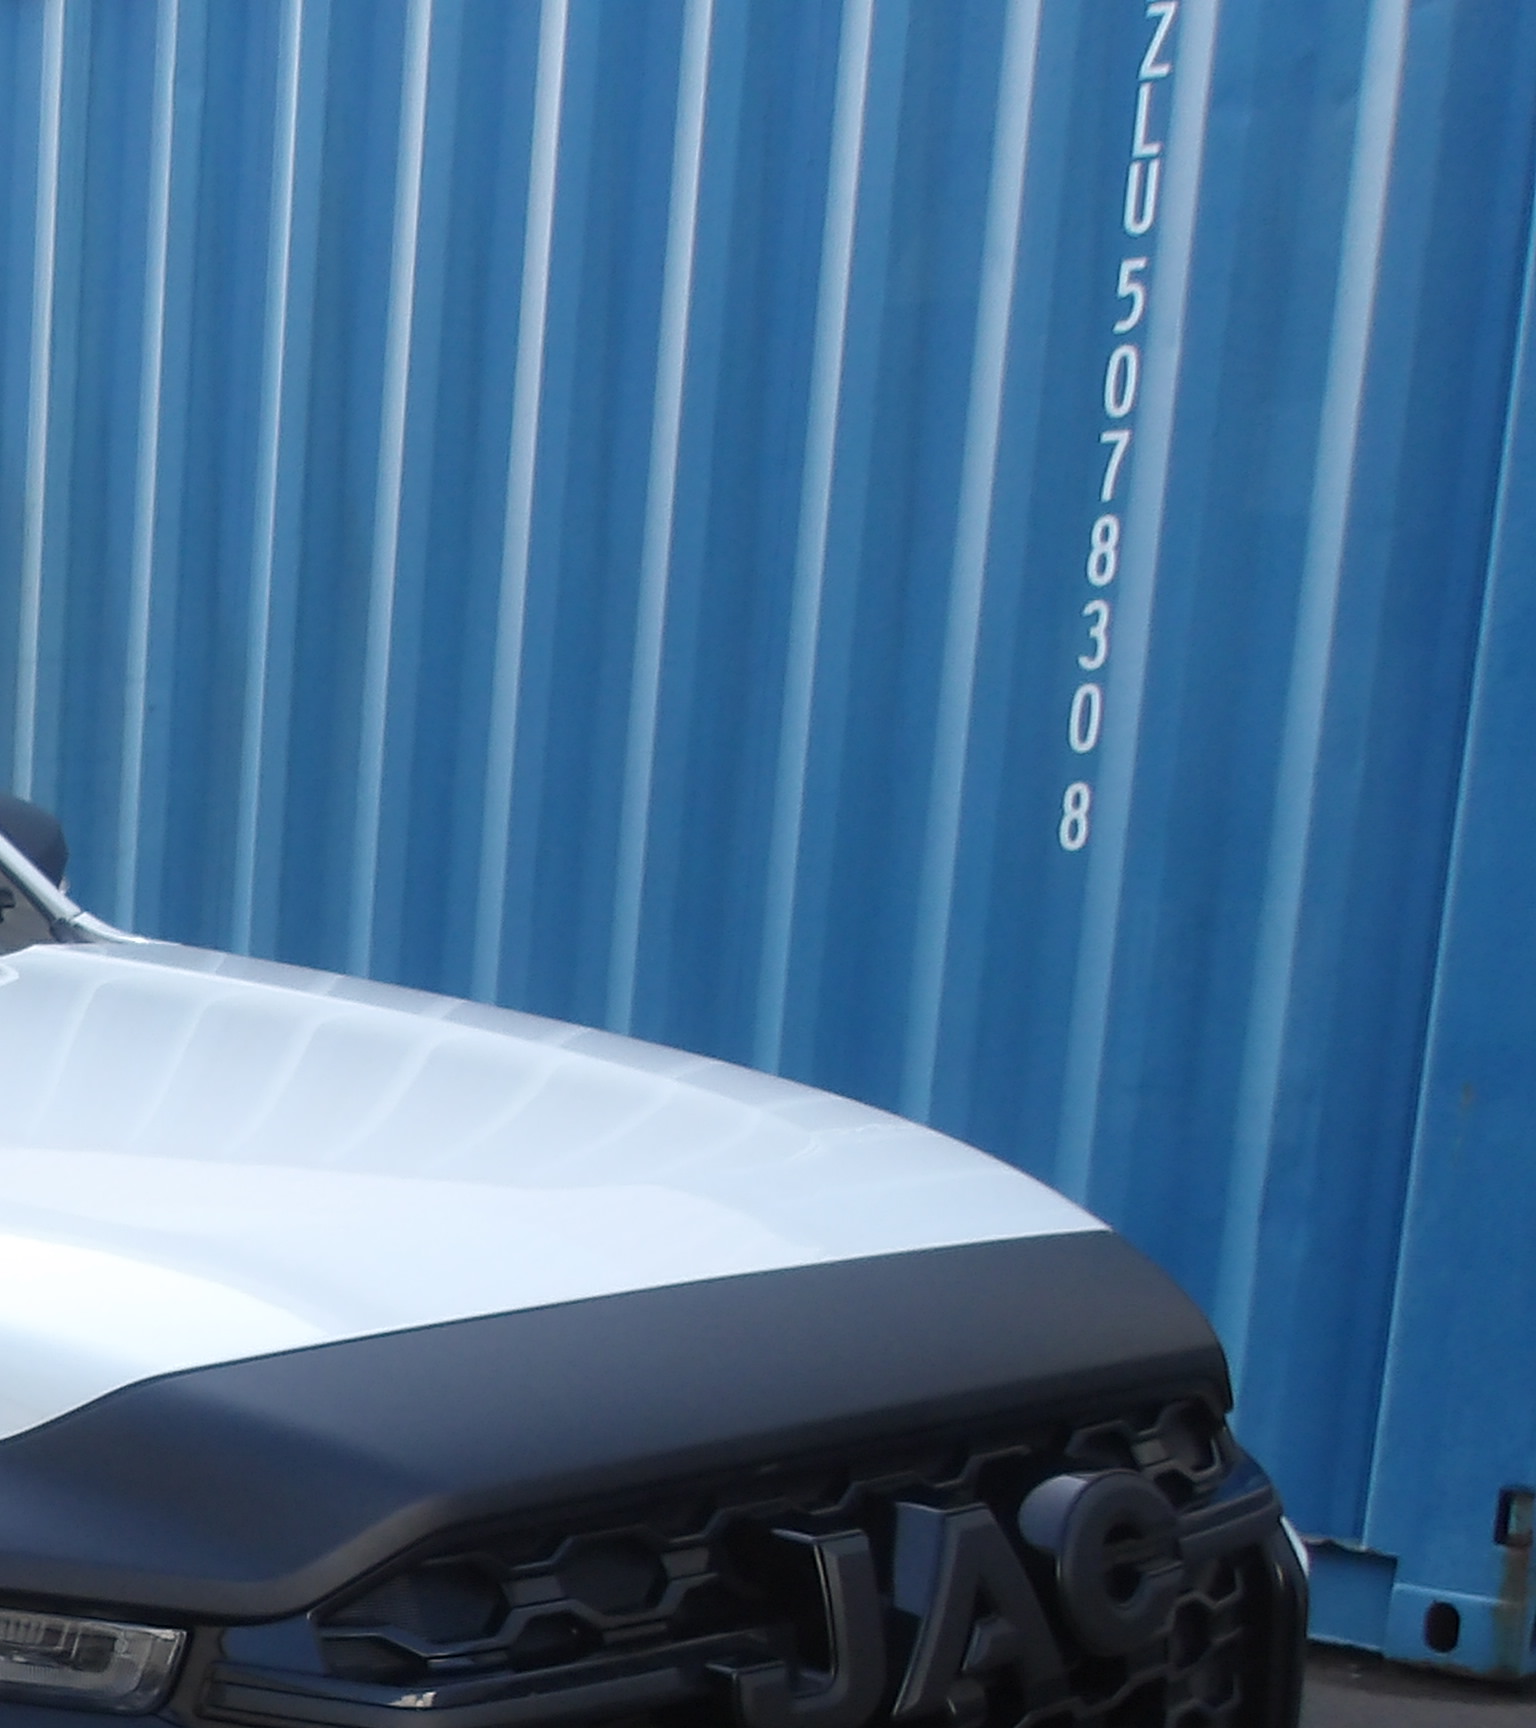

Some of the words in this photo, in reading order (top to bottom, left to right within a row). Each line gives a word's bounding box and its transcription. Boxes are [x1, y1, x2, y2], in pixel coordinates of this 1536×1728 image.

[1123, 1, 1177, 237] ZLU
[1066, 256, 1148, 755] 507830
[1058, 781, 1091, 853] 8
